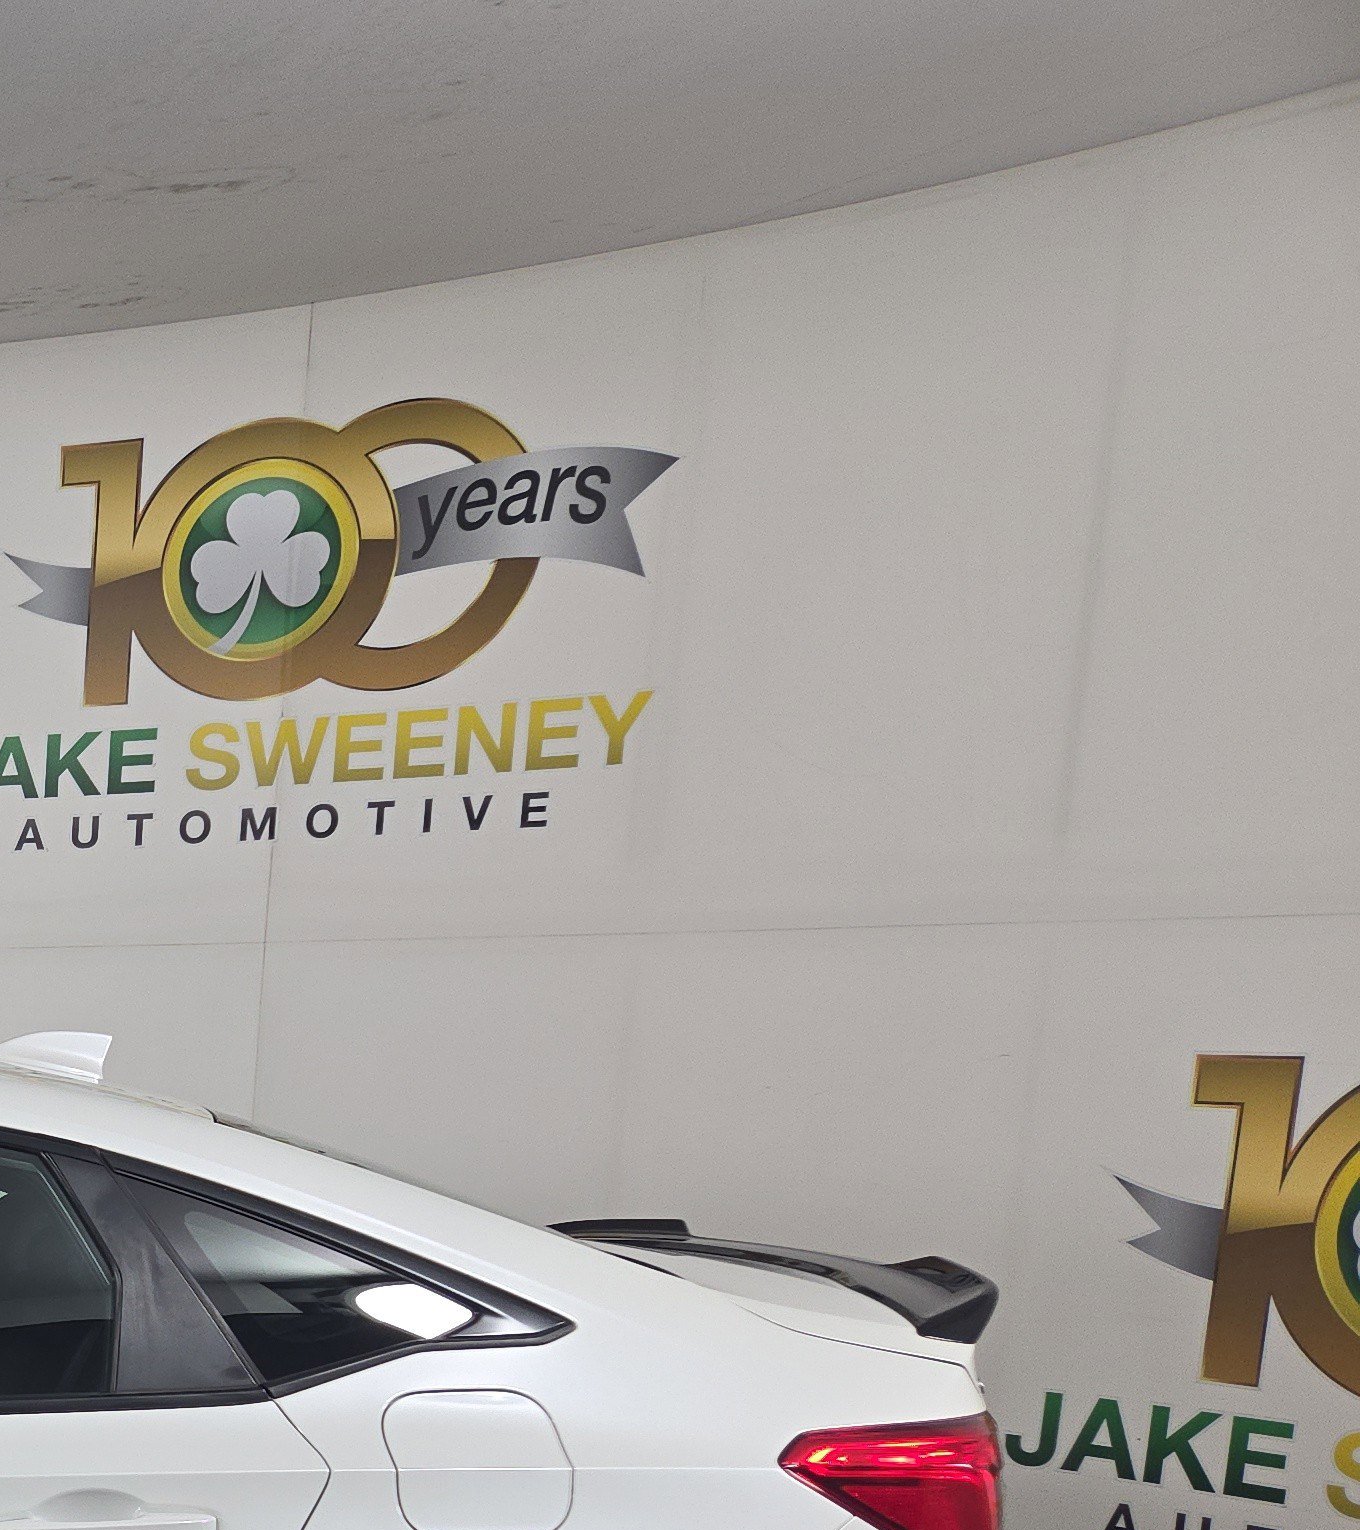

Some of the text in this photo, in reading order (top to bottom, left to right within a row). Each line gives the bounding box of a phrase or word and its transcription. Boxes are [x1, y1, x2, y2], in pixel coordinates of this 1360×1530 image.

[411, 465, 611, 560] years
[185, 690, 654, 791] SWEENEY
[15, 792, 551, 852] AUTOMOTIVE
[1005, 1392, 1294, 1505] JAKE
